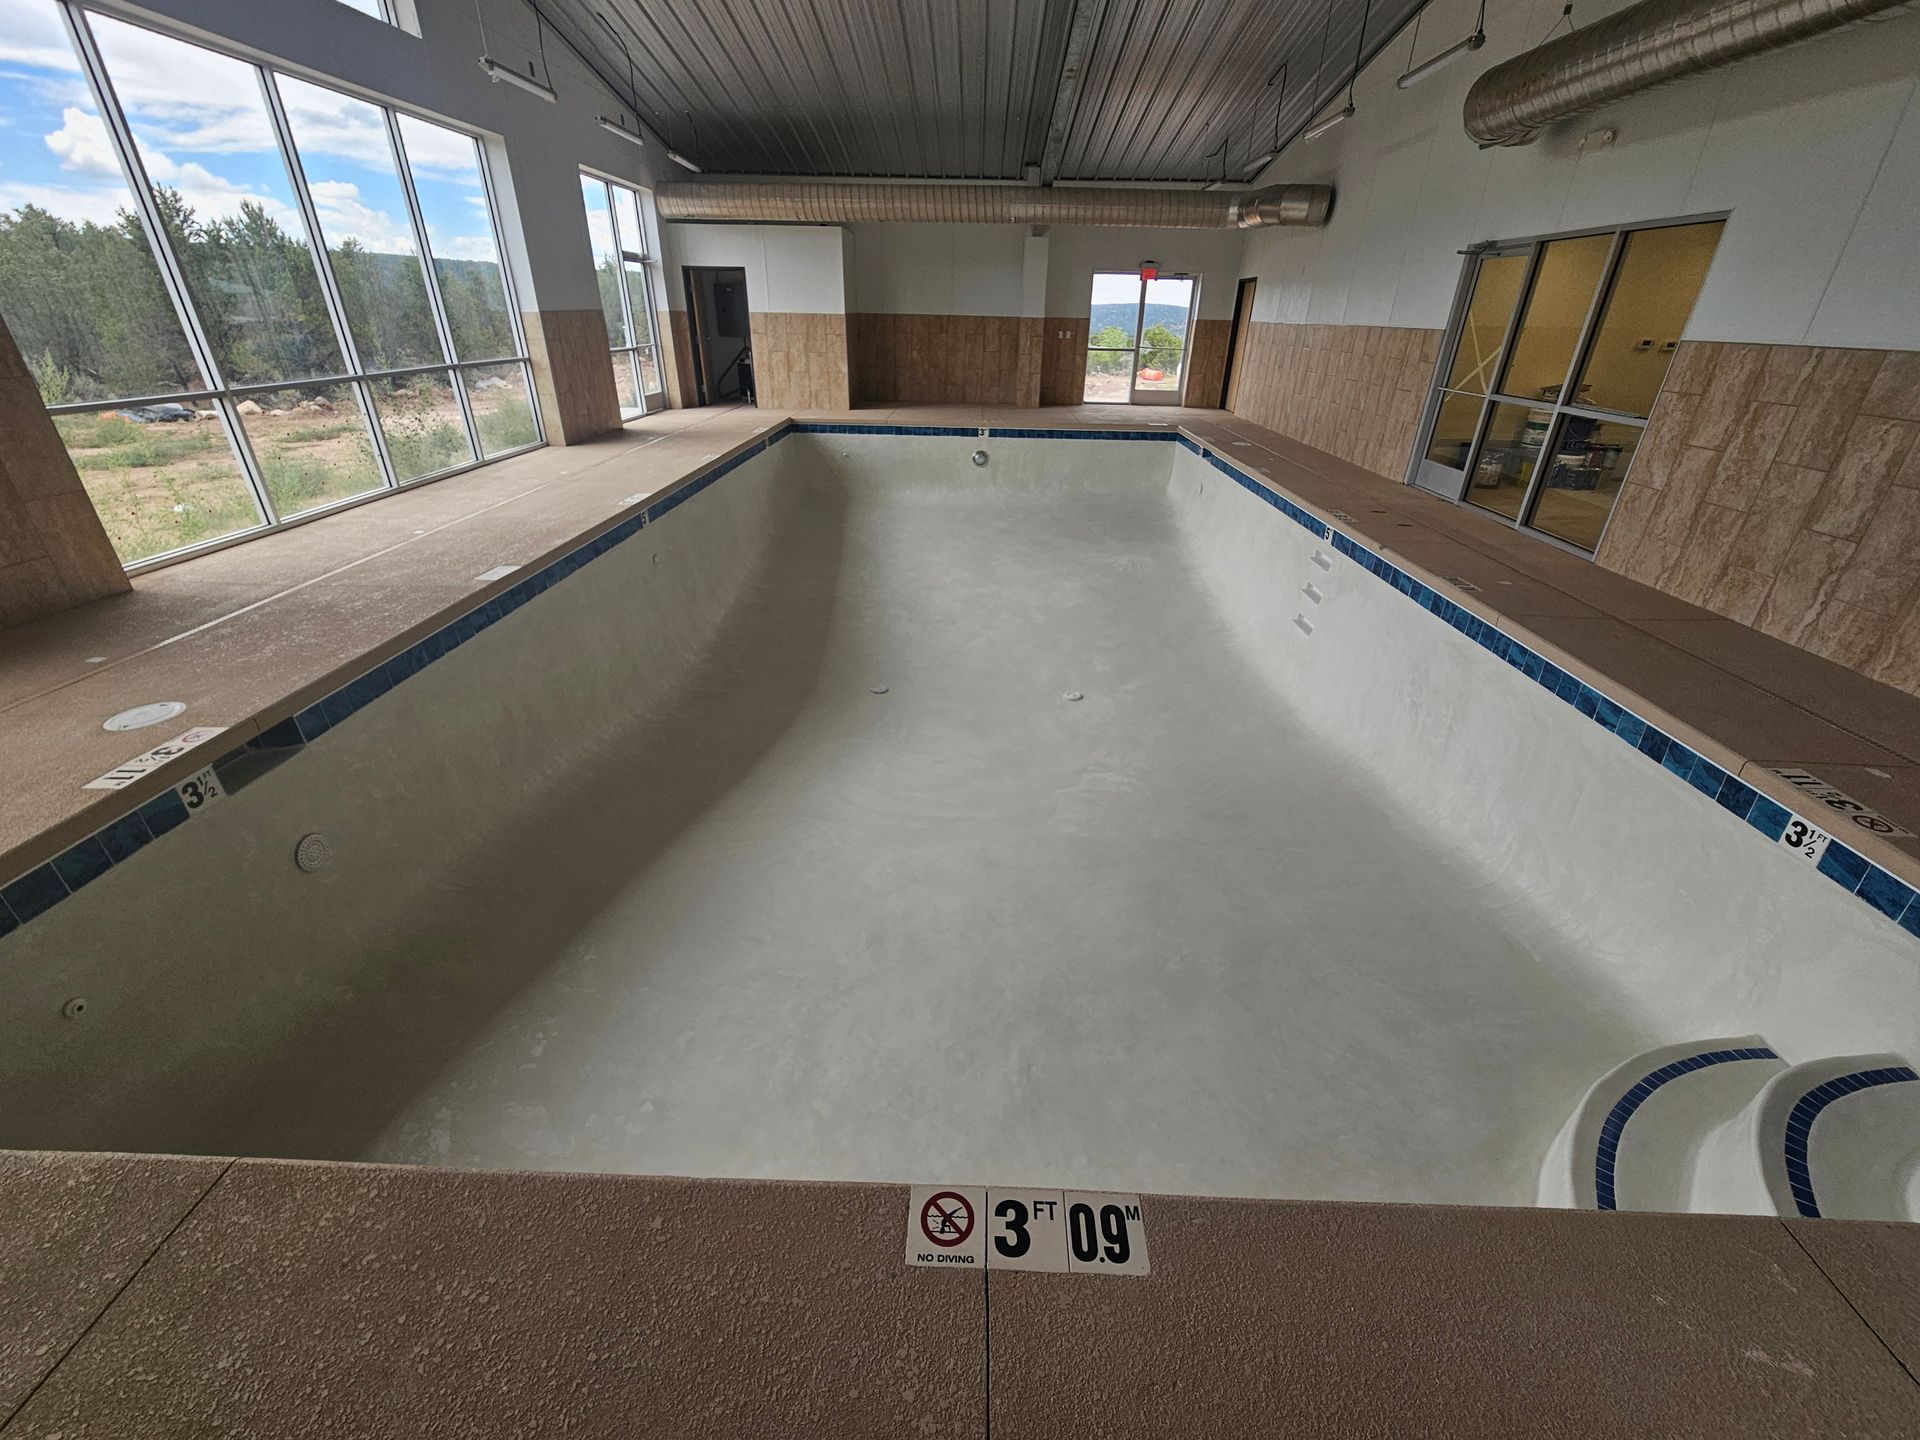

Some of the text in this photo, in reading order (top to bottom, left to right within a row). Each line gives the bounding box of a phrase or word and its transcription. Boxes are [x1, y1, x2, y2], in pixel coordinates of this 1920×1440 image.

[1816, 833, 1829, 844] FT
[993, 1199, 1141, 1264] 3 FT 0.9 M
[917, 1253, 975, 1264] NO DIVING
